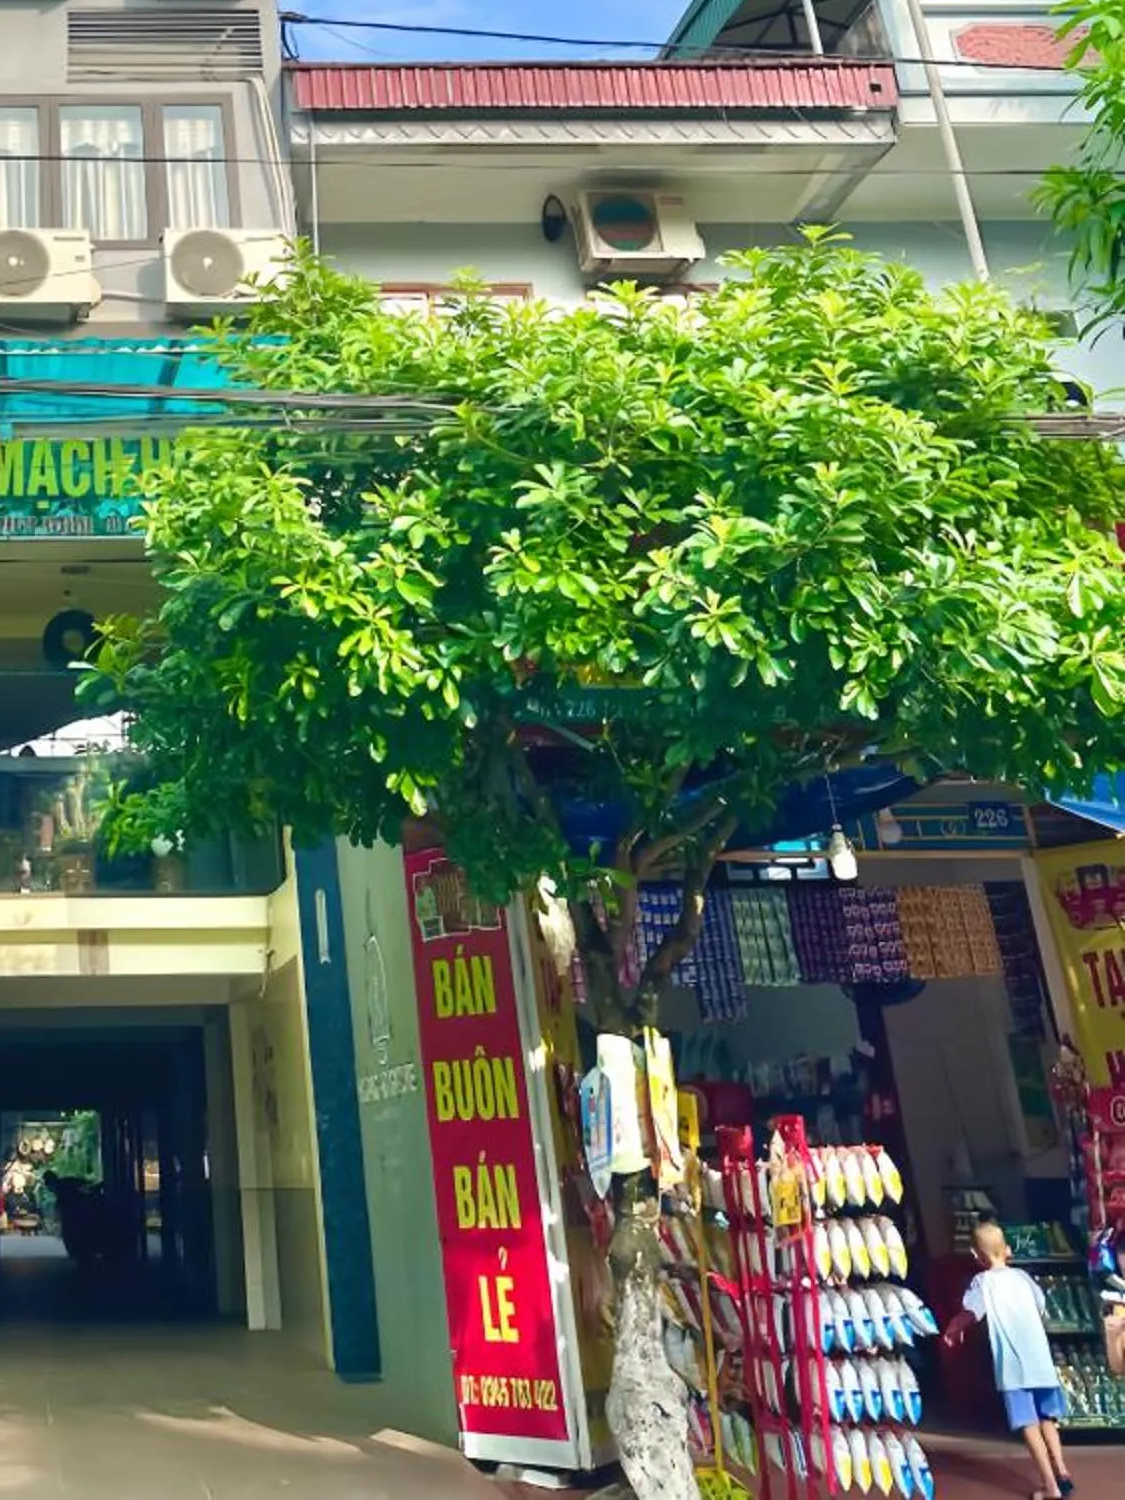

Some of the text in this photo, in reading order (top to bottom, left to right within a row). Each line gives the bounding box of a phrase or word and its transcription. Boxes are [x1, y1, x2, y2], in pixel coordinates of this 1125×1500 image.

[974, 807, 1009, 828] 226
[431, 943, 498, 1019] BÁN
[431, 1045, 520, 1123] BUÔN
[452, 1150, 523, 1230] BÁN
[478, 1246, 521, 1344] LẺ
